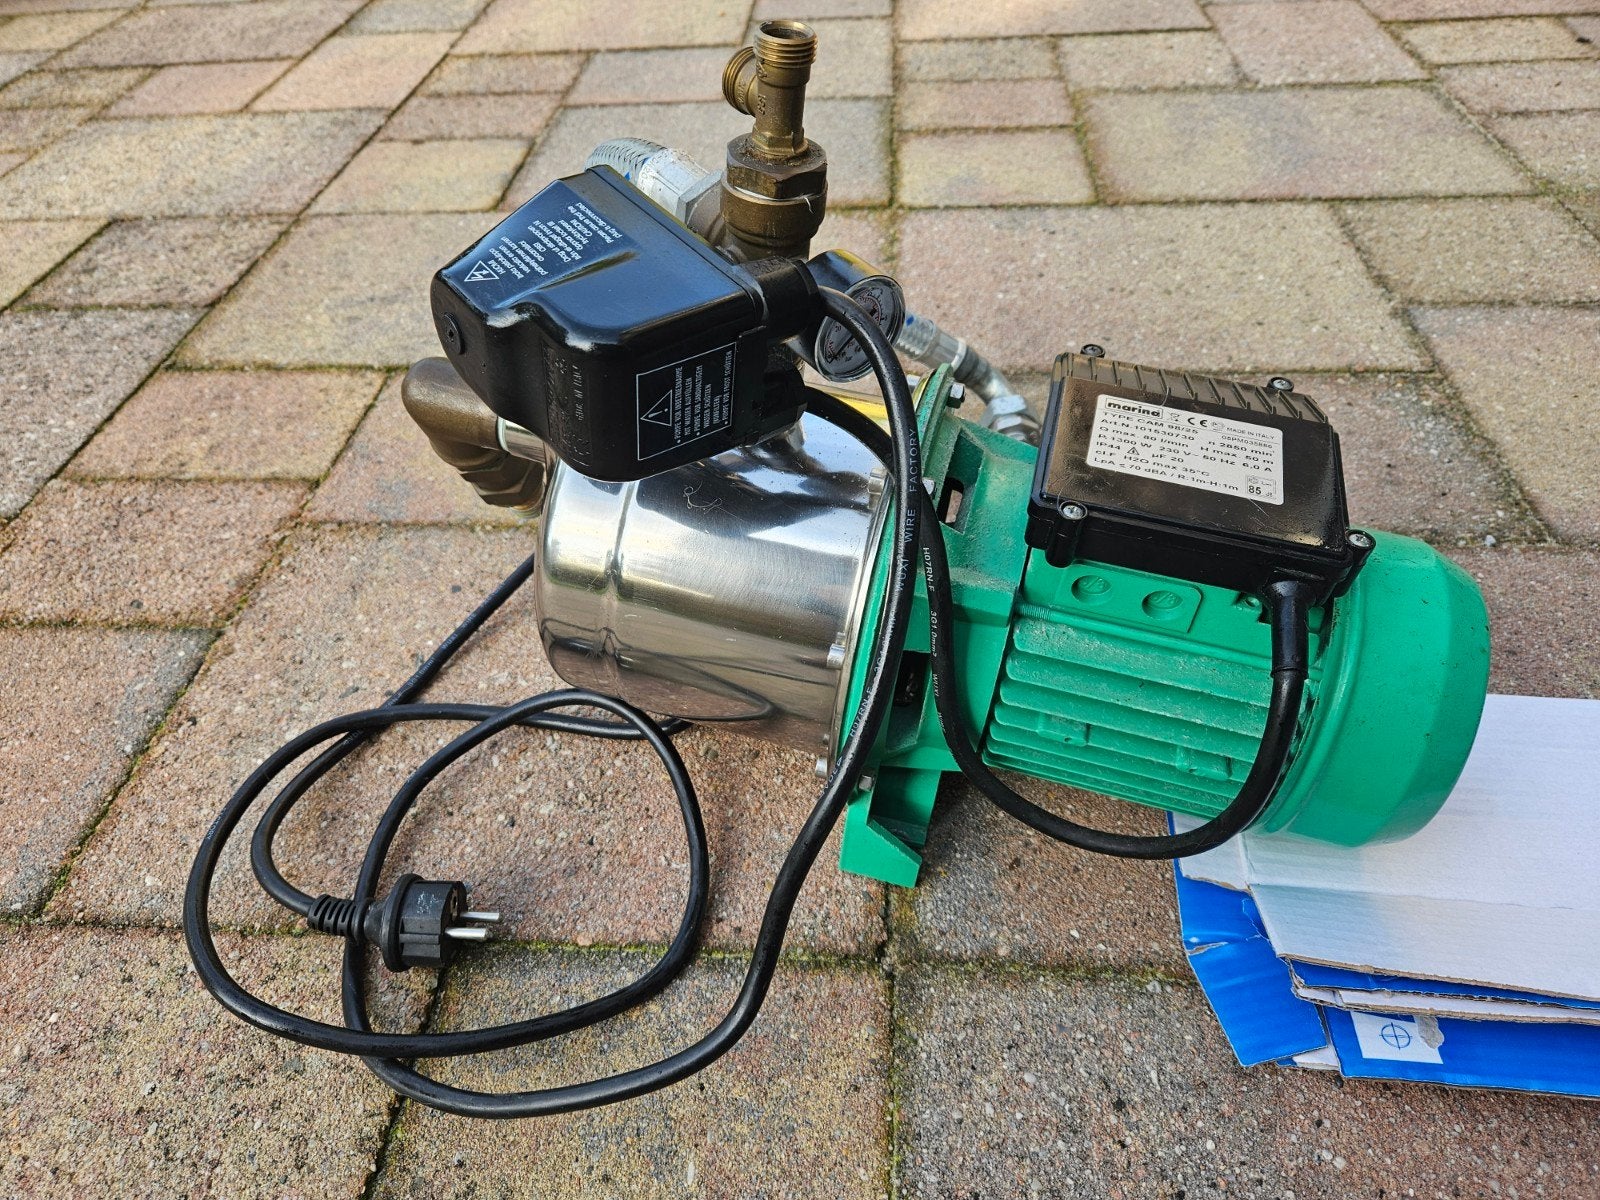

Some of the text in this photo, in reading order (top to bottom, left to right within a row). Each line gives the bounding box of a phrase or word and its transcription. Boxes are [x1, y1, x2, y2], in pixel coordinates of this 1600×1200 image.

[567, 205, 613, 243] Please ensure that the
[608, 228, 622, 238] plug
[1106, 401, 1160, 417] marina
[1103, 411, 1198, 434] TYPE CAM 98/25
[1226, 426, 1245, 434] MADE
[1254, 432, 1275, 440] ITALY
[1095, 440, 1121, 450] IP44
[909, 429, 918, 492] FACTORY
[1123, 454, 1149, 464] H2O
[1159, 445, 1180, 454] 230
[1219, 457, 1235, 465] Hz
[1247, 484, 1262, 495] 85
[904, 509, 916, 543] WIRE
